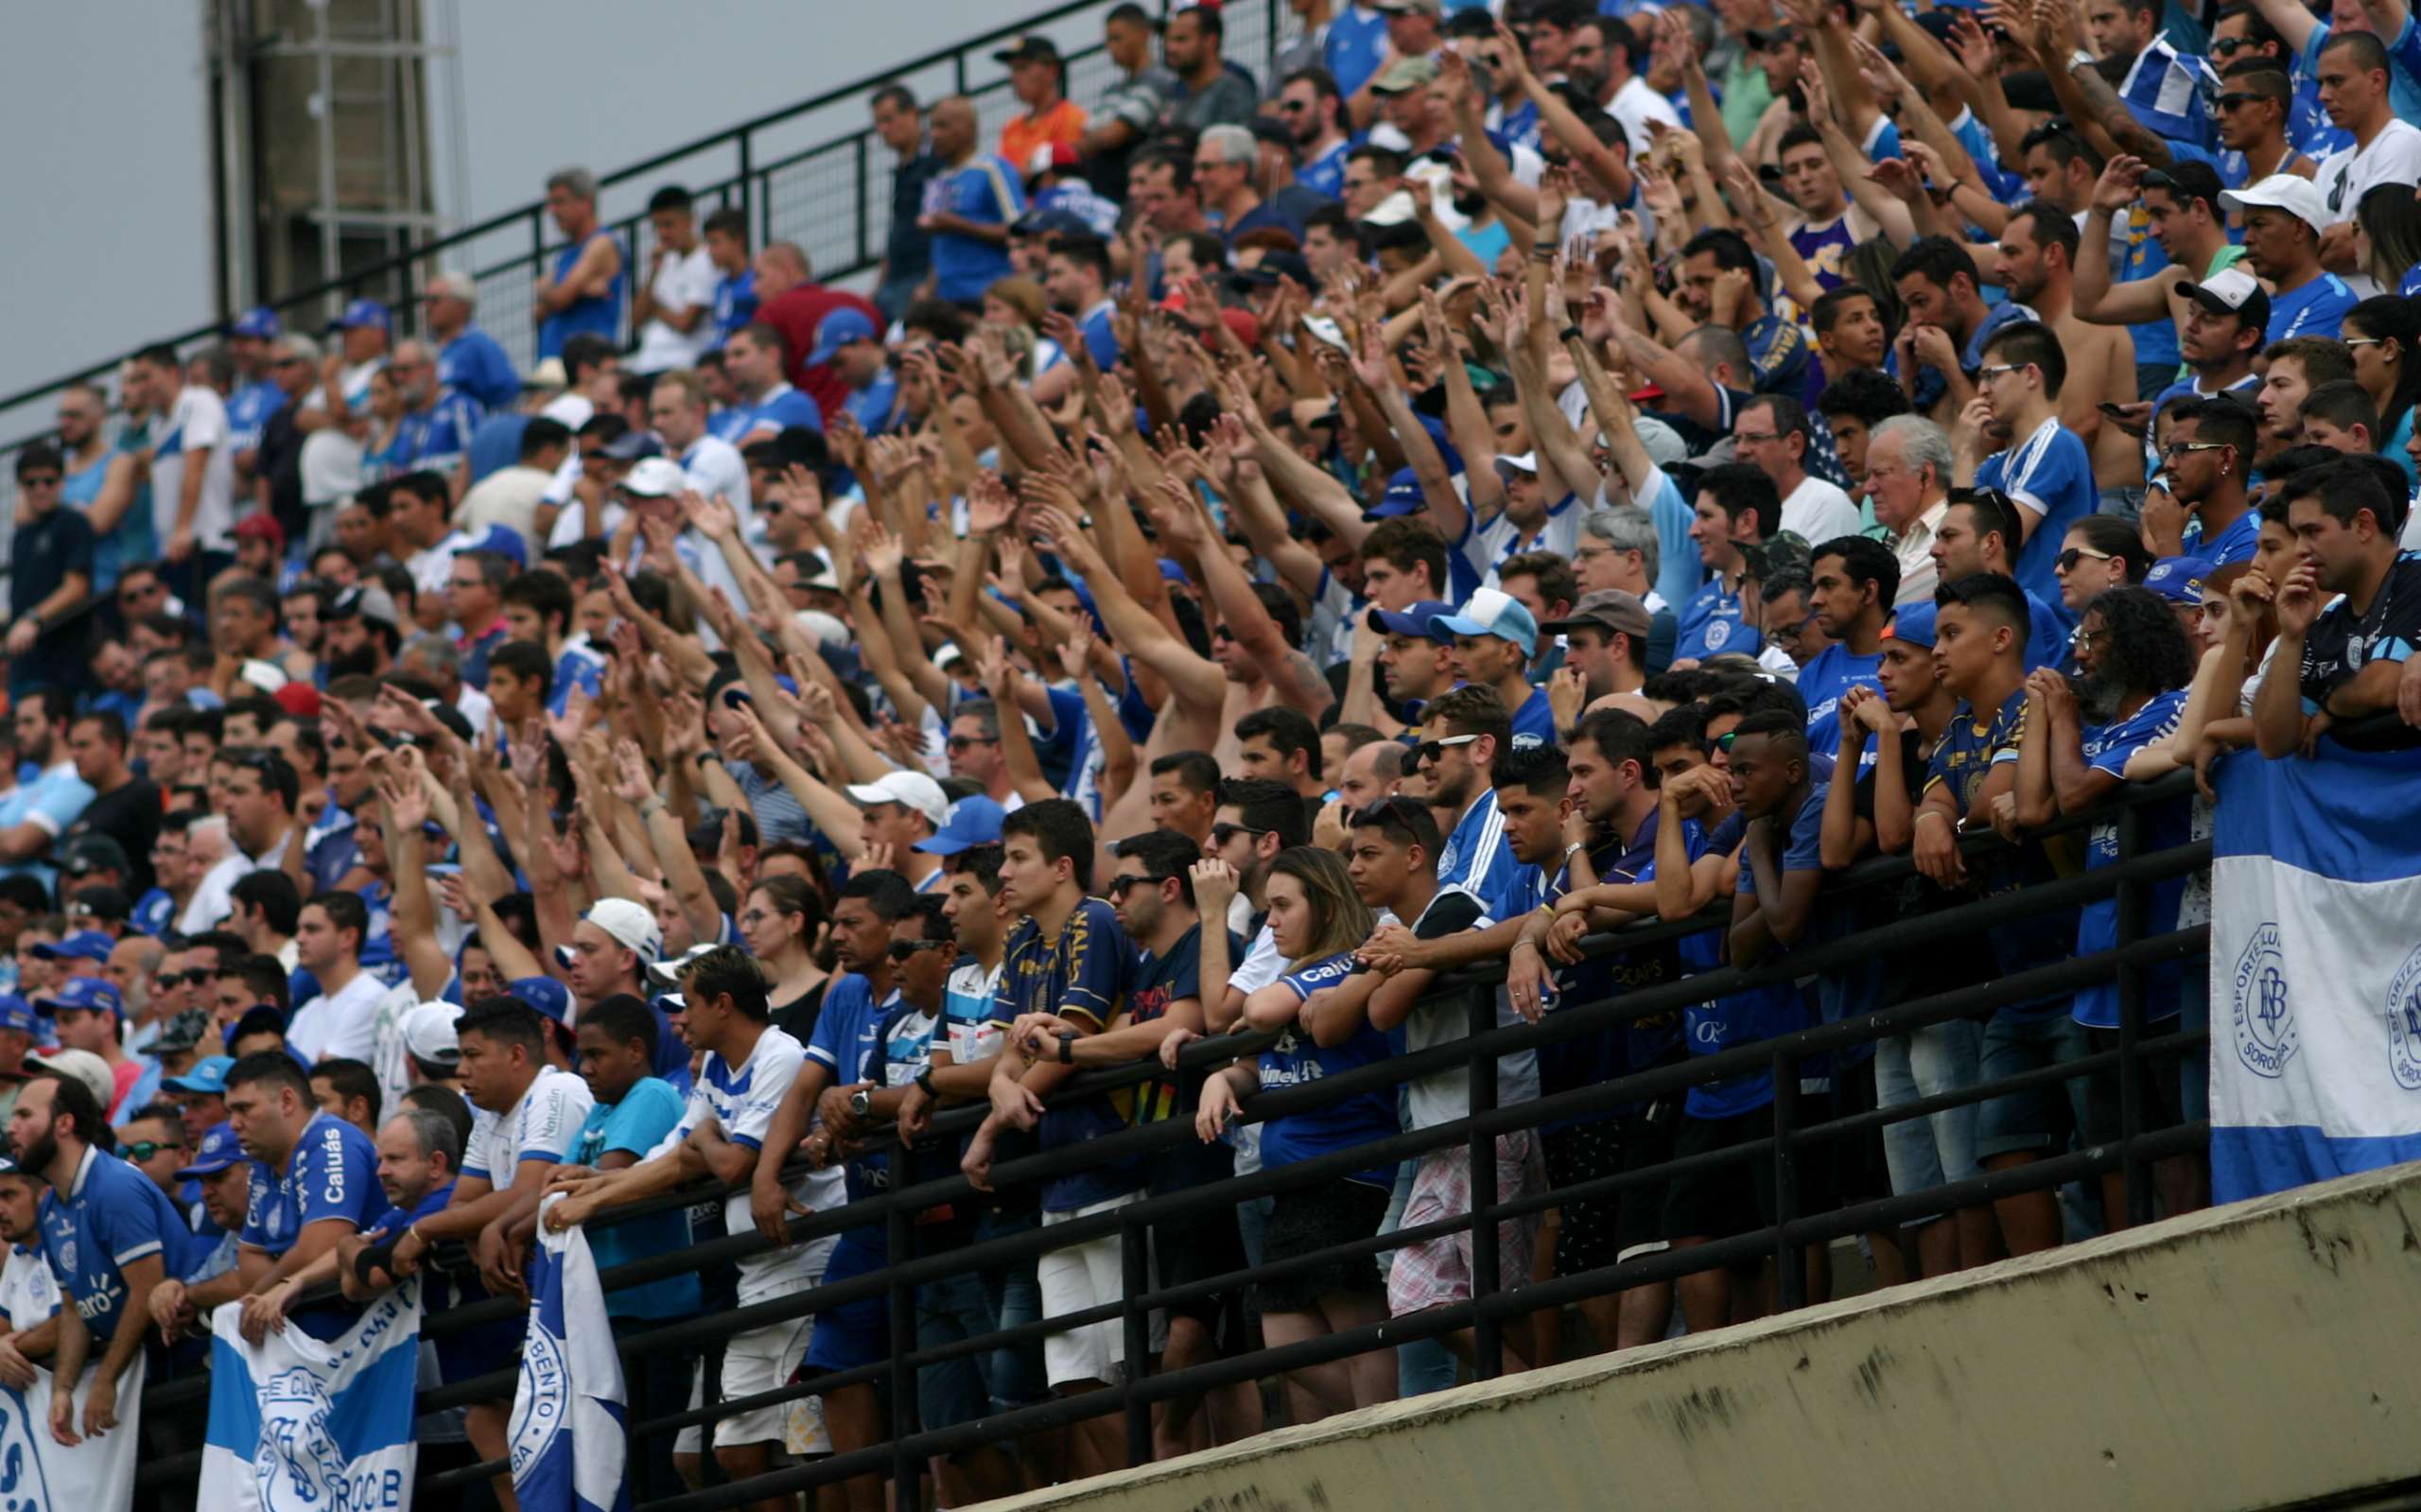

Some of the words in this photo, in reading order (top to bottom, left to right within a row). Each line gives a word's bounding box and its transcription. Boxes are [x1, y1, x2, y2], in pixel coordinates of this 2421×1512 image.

[1300, 951, 1355, 982] Caiu
[2234, 943, 2262, 1027] ESPORTE
[322, 1128, 344, 1204] Caiuás
[77, 1292, 112, 1318] aro
[531, 1341, 556, 1417] BENTO
